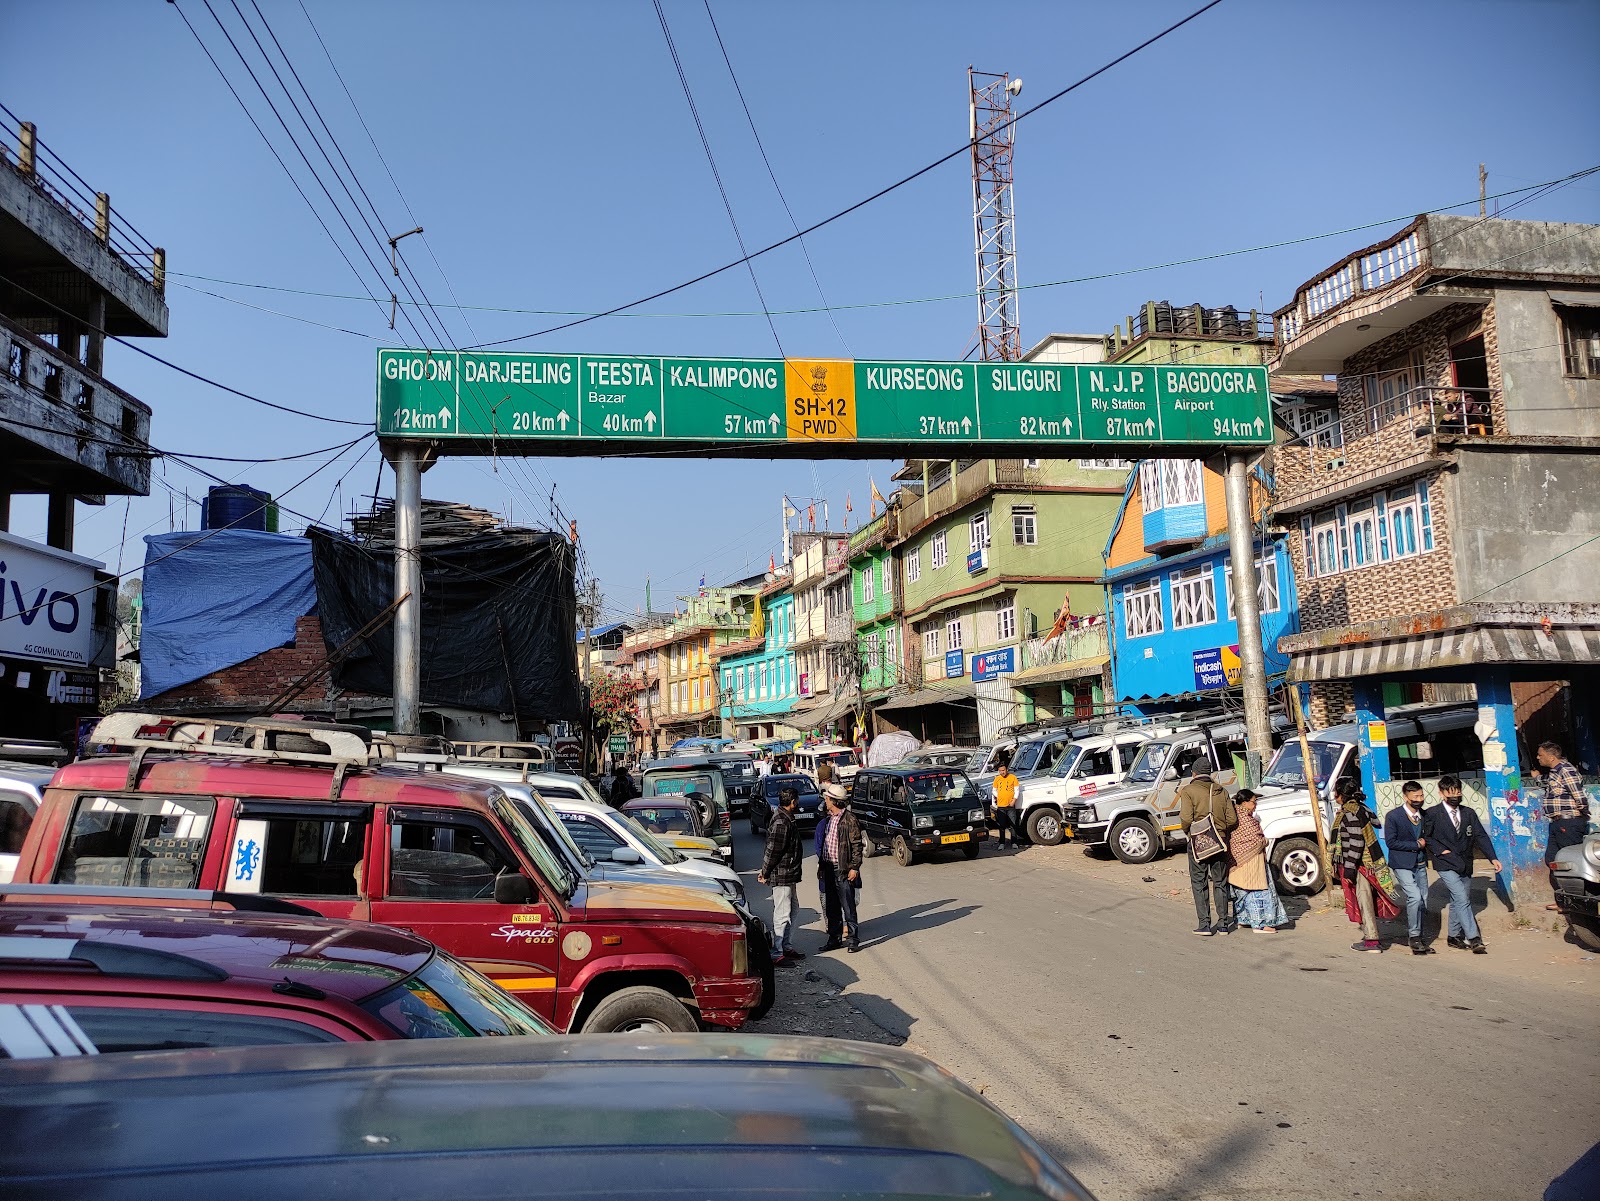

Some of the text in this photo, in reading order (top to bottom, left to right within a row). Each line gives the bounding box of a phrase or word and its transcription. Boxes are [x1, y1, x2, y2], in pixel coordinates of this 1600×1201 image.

[384, 357, 452, 382] GHOOM
[465, 360, 572, 385] DARJEELING
[586, 361, 655, 386] TEESTA
[670, 365, 778, 390] KALIMPONG
[866, 367, 964, 391] KURSEONG
[991, 368, 1061, 393] SILIGURI
[1166, 371, 1258, 394] BAGDOGRA
[588, 391, 627, 404] Bazar
[793, 397, 847, 416] SH-12
[1091, 397, 1146, 412] Rly. Station
[1174, 398, 1215, 412] Airport
[803, 419, 837, 435] PWD
[24, 644, 83, 660] 4G COMMUNICATION
[1195, 660, 1222, 673] indicash
